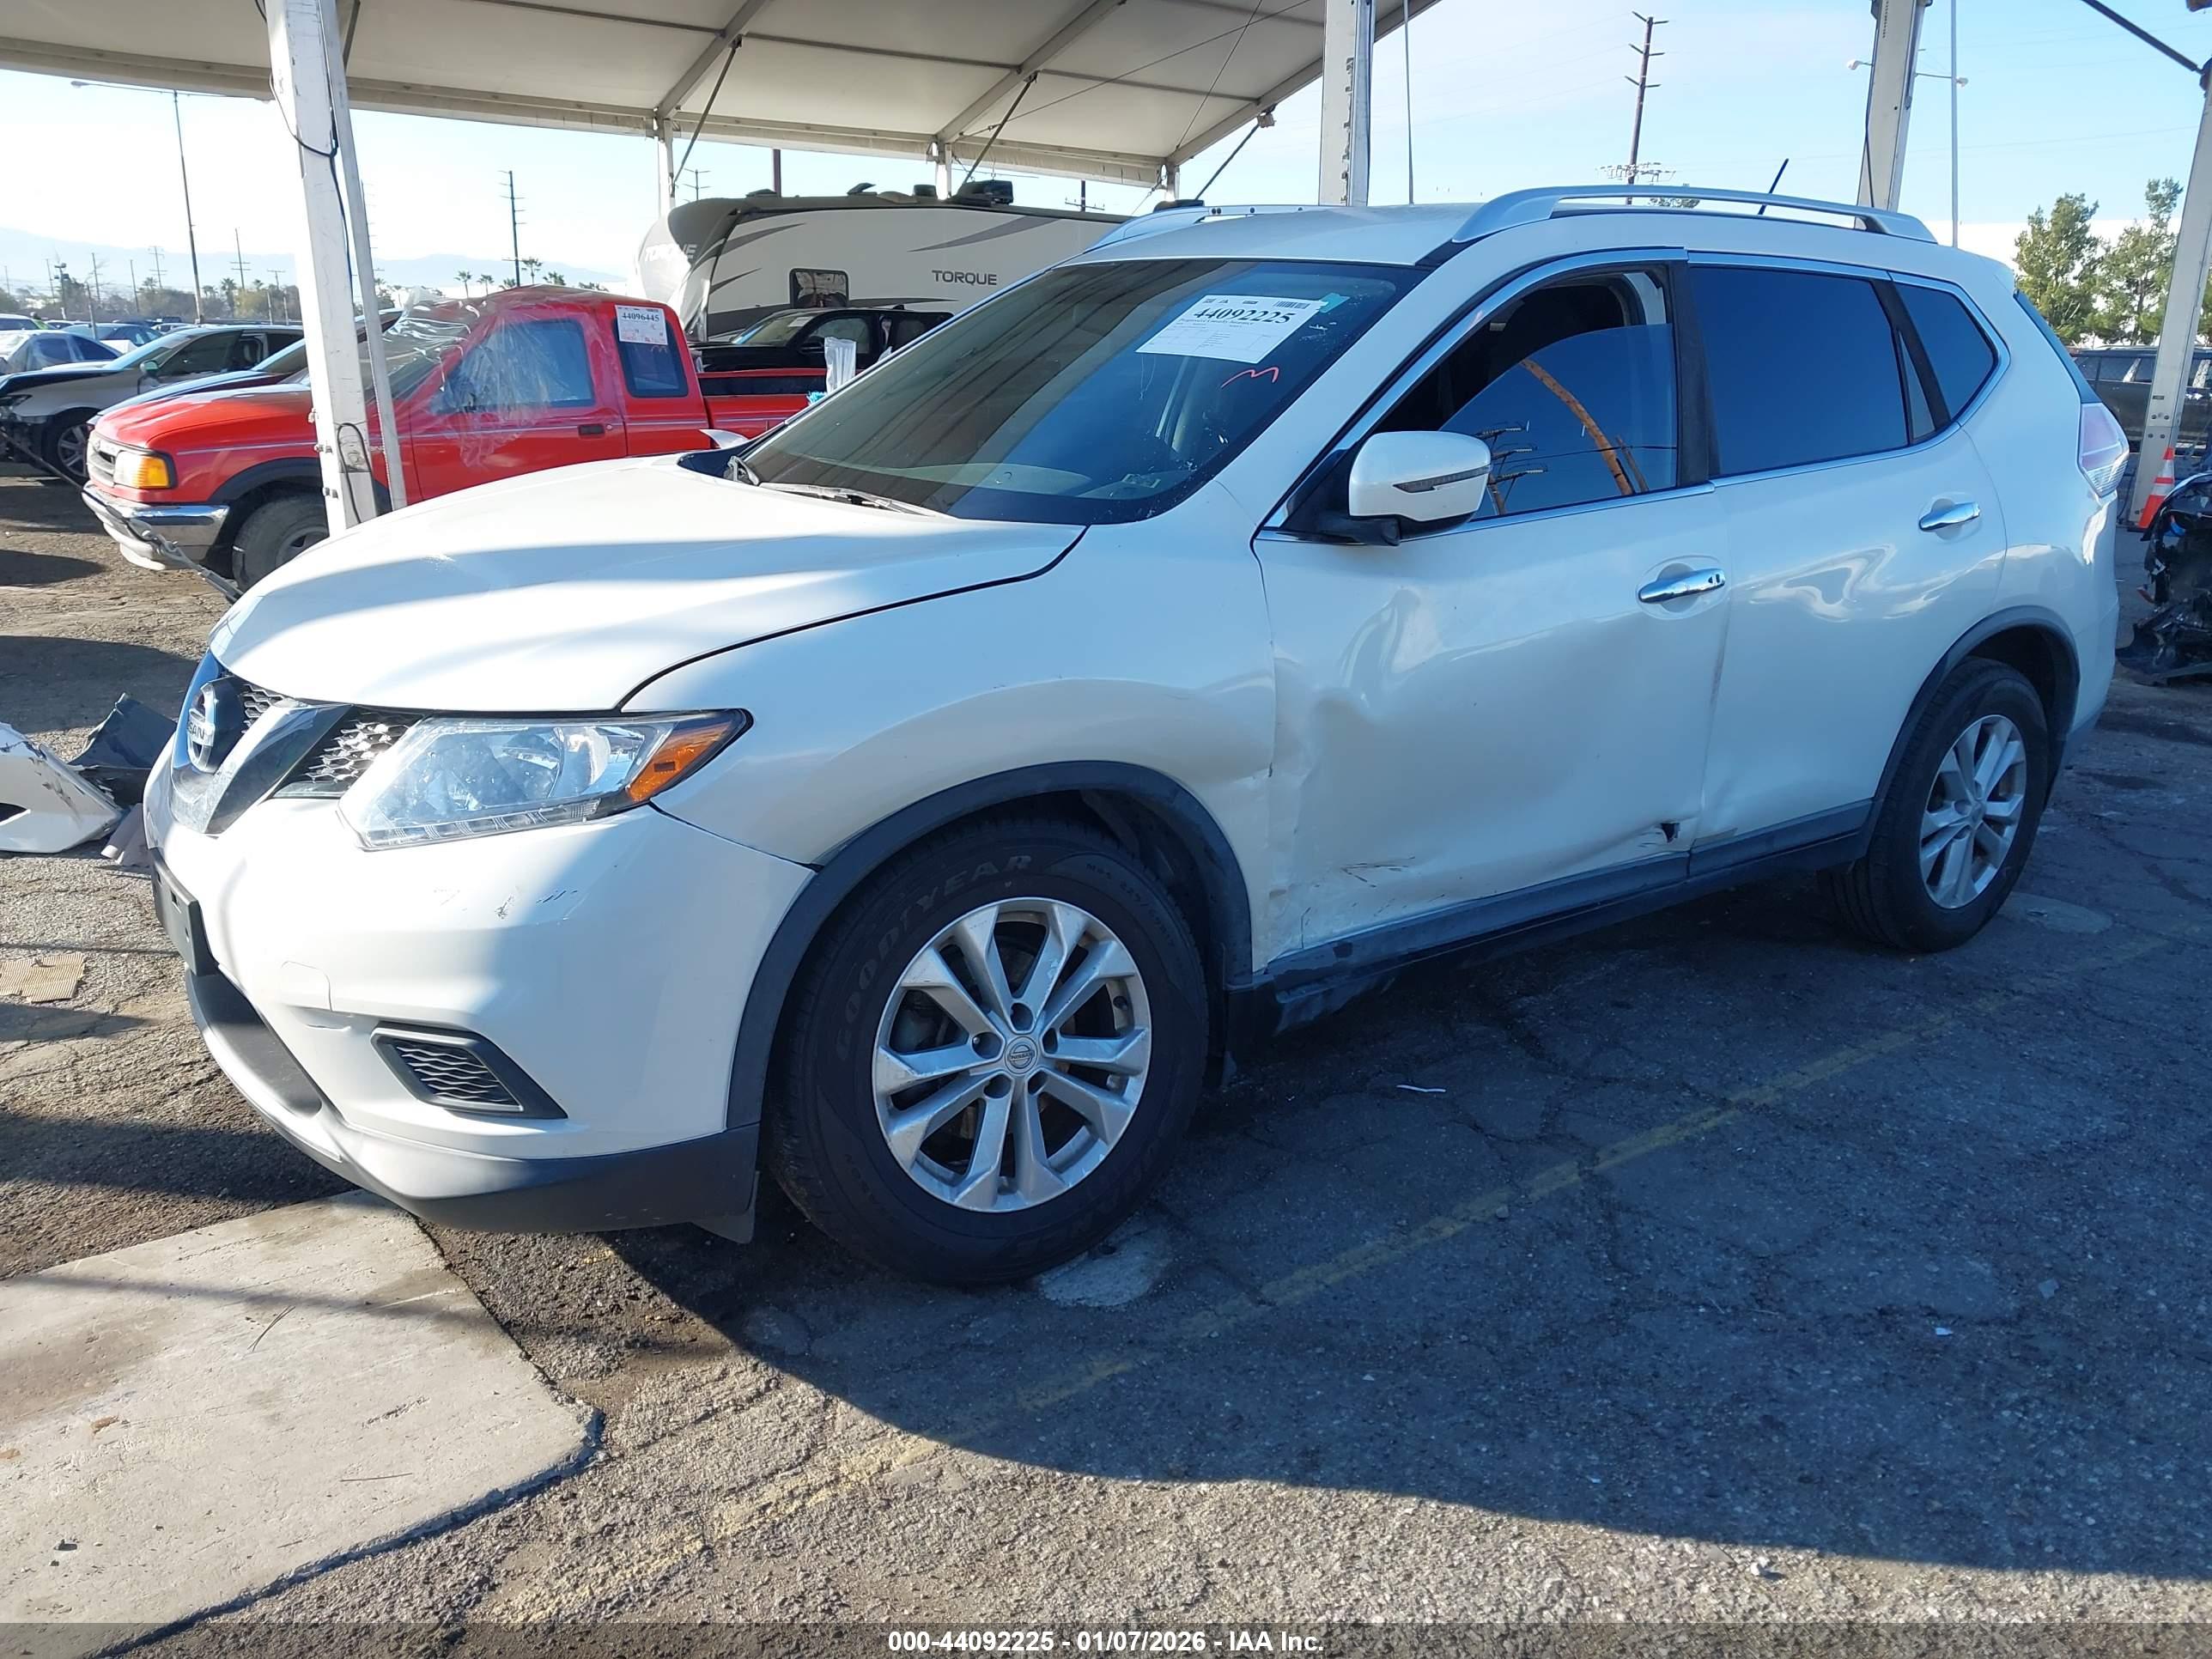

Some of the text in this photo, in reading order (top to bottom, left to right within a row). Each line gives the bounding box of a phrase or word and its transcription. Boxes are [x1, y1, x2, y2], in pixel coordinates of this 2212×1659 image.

[932, 270, 997, 286] TORQUE
[622, 312, 660, 322] 44096445
[1194, 307, 1297, 324] 44092225
[836, 855, 1032, 1060] GOODYEAR
